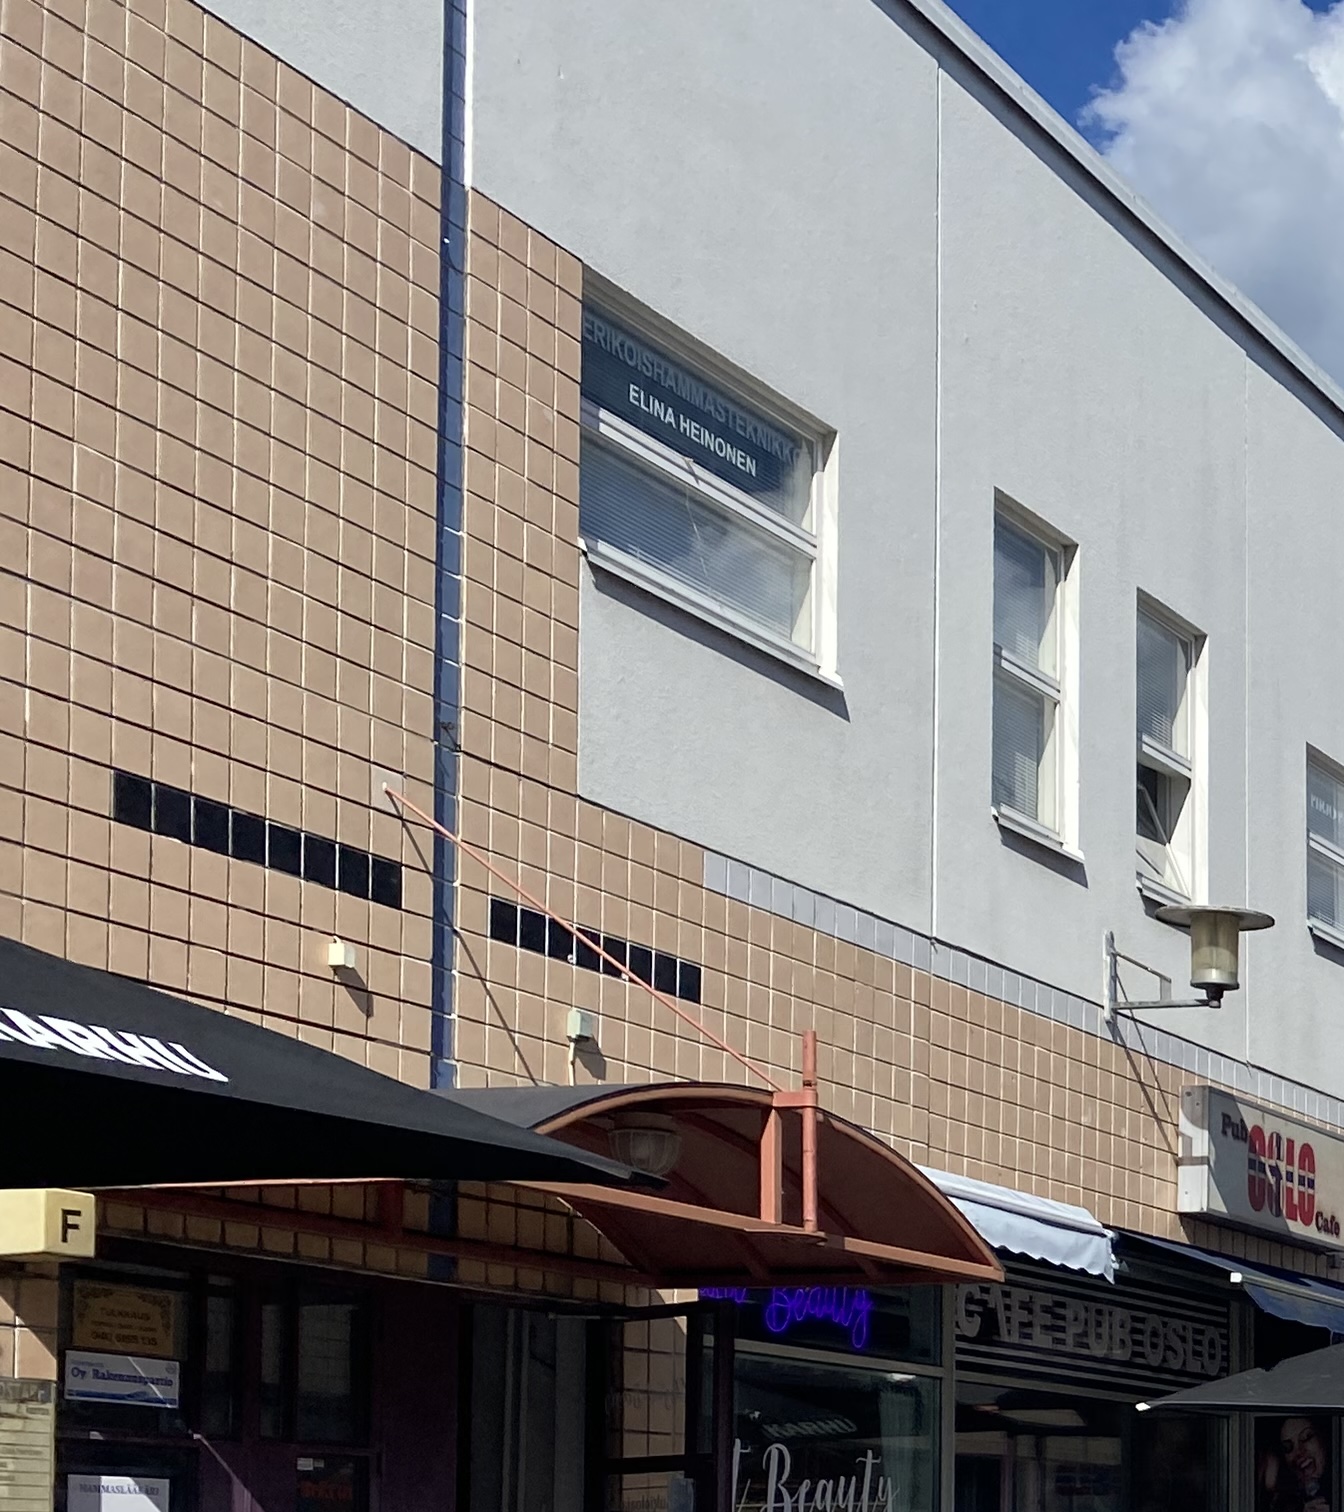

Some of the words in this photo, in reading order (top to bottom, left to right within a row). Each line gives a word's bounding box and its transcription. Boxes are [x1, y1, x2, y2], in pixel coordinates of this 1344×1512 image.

[629, 383, 676, 429] ELINA
[679, 413, 756, 478] HEINONEN
[0, 1006, 229, 1082] ARHU
[1221, 1112, 1248, 1143] Pub
[1248, 1124, 1316, 1227] OSLO
[1315, 1211, 1340, 1238] Cafe
[61, 1208, 82, 1243] F
[1066, 1300, 1133, 1361] PUB
[1143, 1313, 1222, 1376] OSLO
